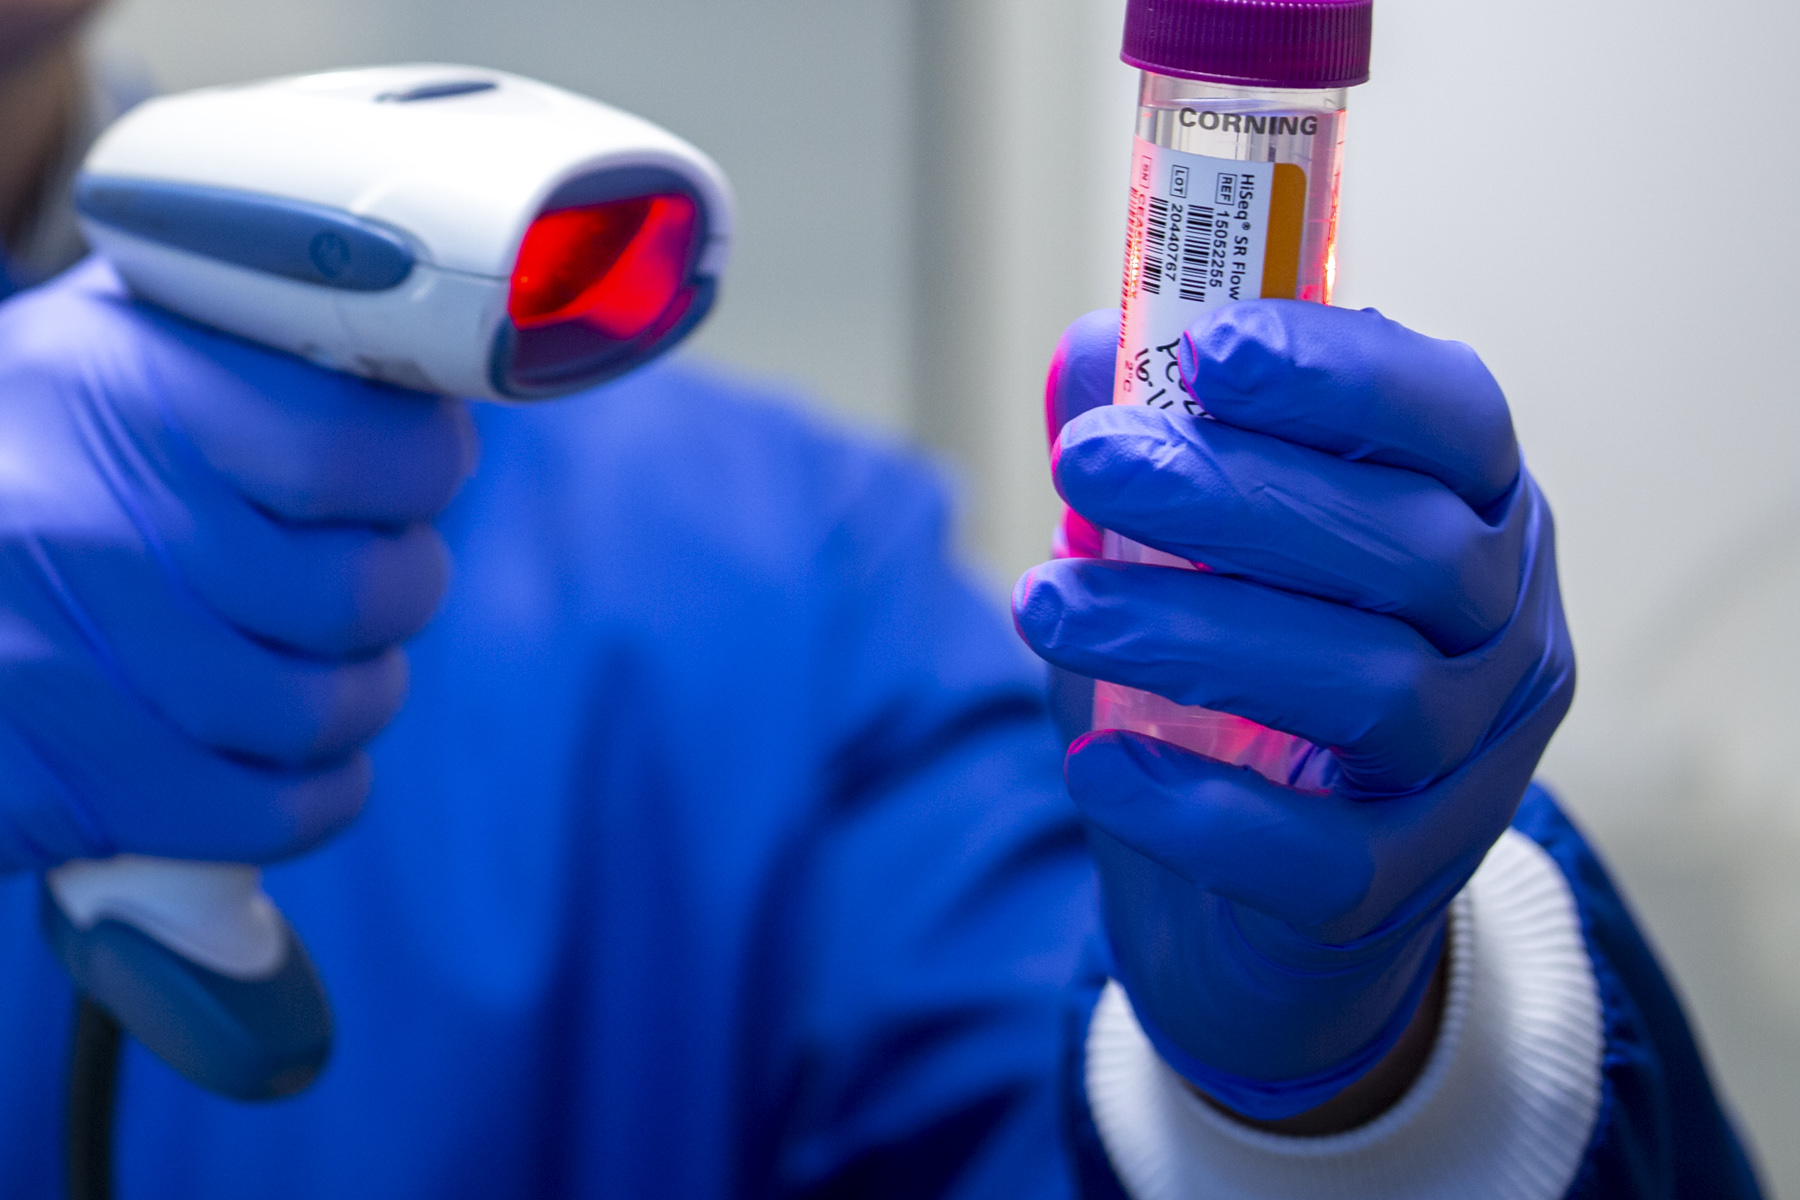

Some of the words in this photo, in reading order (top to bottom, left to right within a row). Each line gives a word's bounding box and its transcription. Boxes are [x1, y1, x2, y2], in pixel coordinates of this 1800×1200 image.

[1179, 107, 1319, 136] CORNING
[1173, 169, 1185, 195] LOT
[1220, 177, 1233, 202] REF
[1165, 203, 1183, 282] 20440767
[1209, 210, 1230, 288] 15052255
[1233, 235, 1249, 256] SR
[1228, 261, 1247, 301] Flow
